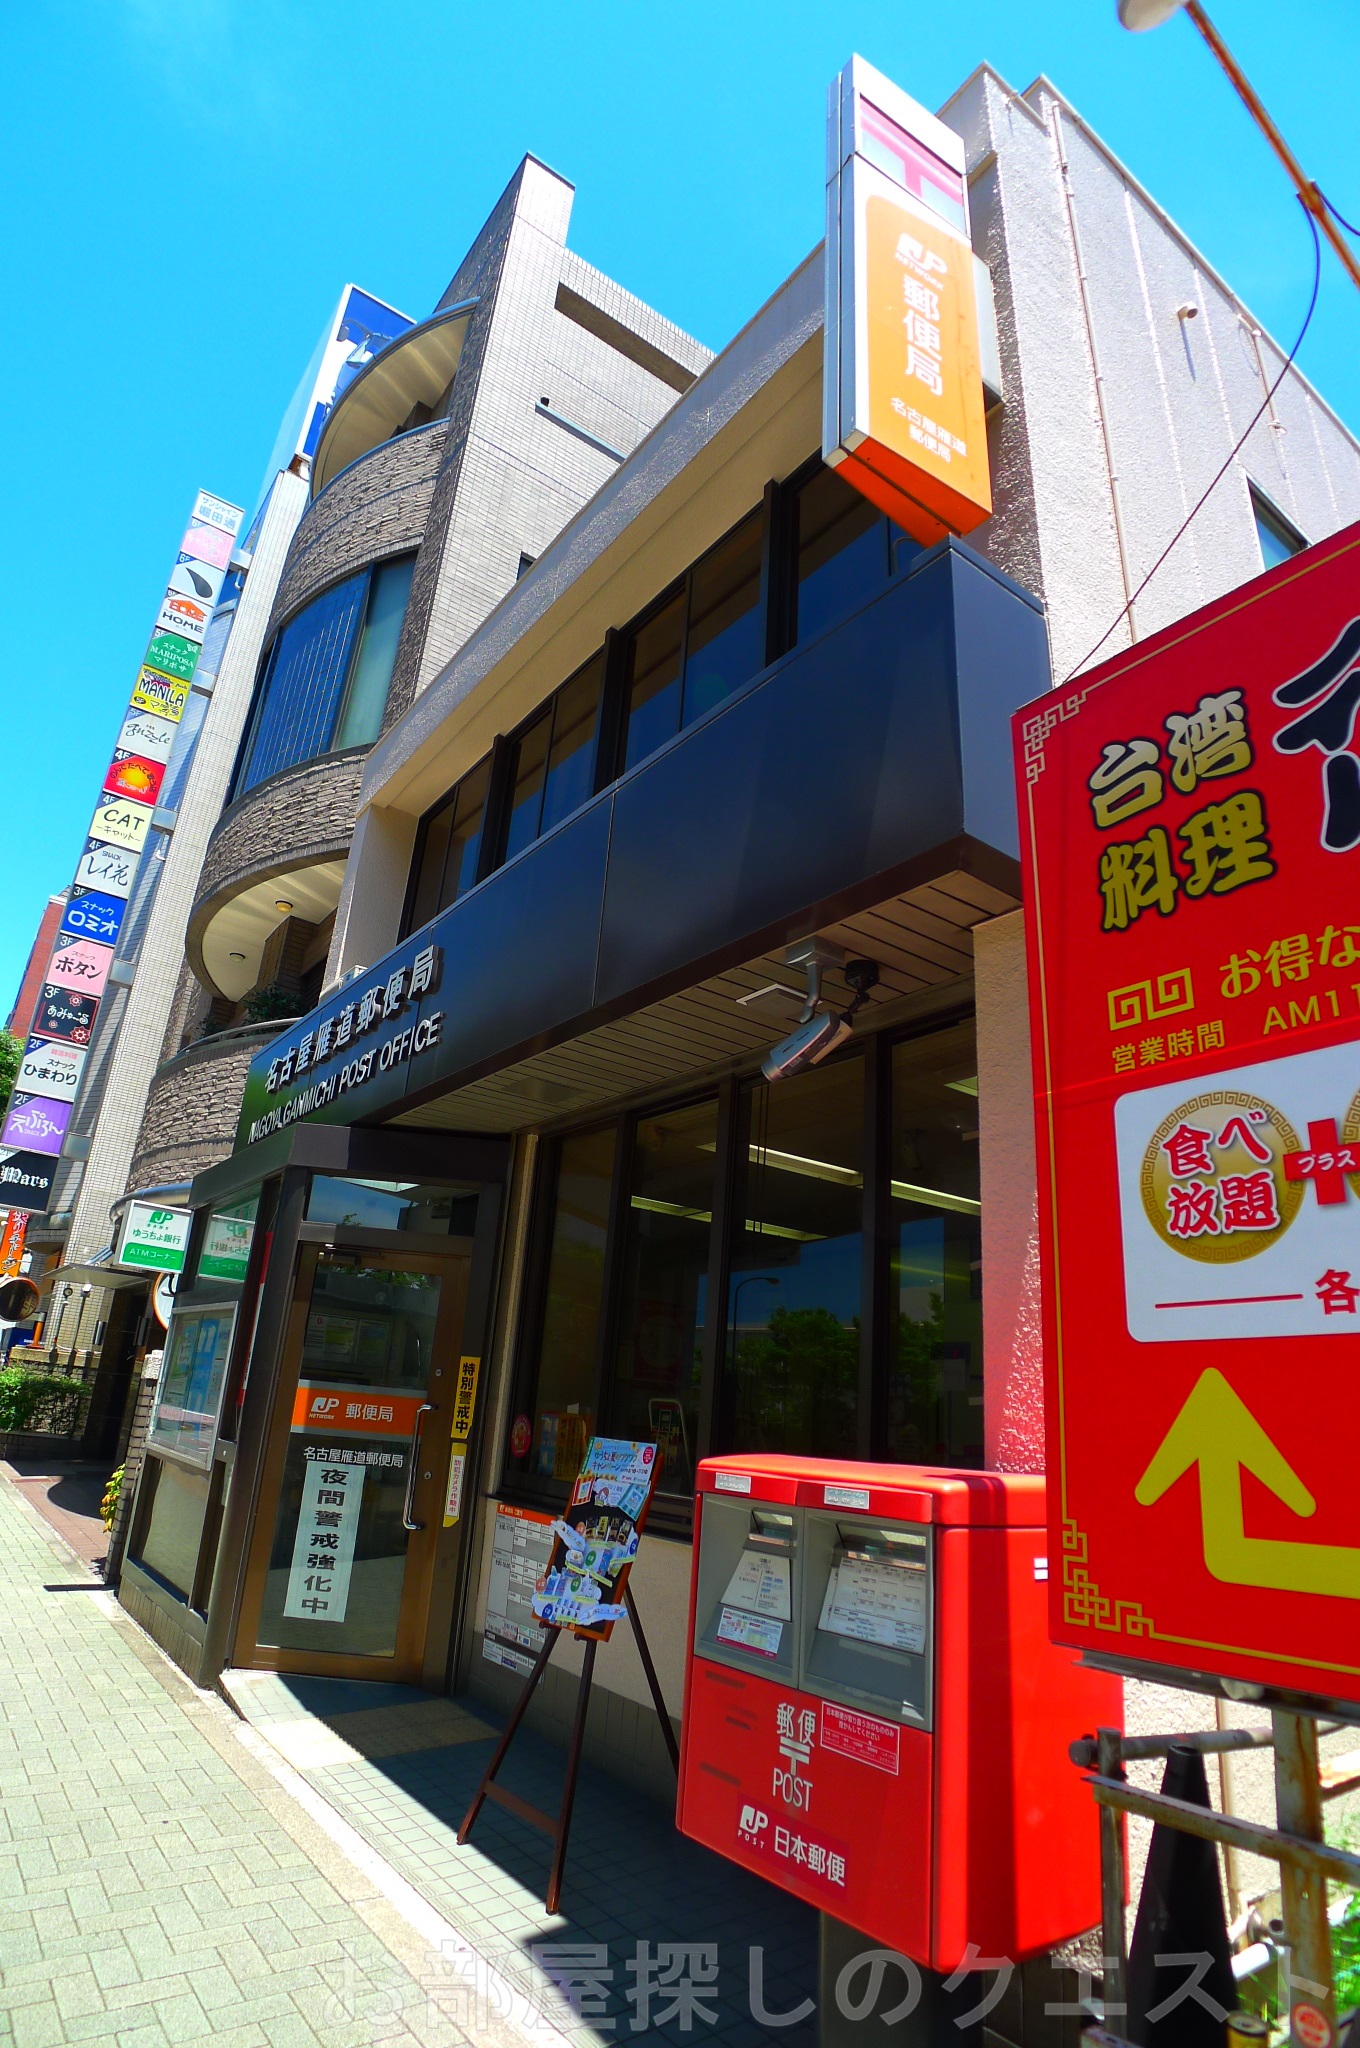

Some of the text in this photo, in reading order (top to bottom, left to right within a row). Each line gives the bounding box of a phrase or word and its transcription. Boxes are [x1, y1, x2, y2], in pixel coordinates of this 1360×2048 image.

[897, 232, 947, 274] JP
[895, 251, 943, 291] NETWORK
[903, 274, 943, 396] 郵便局
[909, 424, 951, 463] 郵便局
[180, 553, 191, 562] 6F
[161, 611, 204, 633] HOME
[149, 645, 194, 668] MARIPOSA
[138, 679, 184, 706] MANILA
[115, 750, 130, 760] 4F
[1088, 688, 1253, 830] 台湾
[103, 794, 116, 804] 4F
[103, 809, 145, 831] CAT
[89, 841, 102, 851] 4F
[1099, 789, 1276, 932] 料理
[73, 886, 86, 896] 3F
[81, 900, 115, 916] スナック
[67, 909, 119, 936] ロミオ
[60, 936, 74, 947] 3F
[55, 956, 104, 980] ボタン
[1219, 924, 1360, 999] お得な
[44, 985, 61, 998] 3F
[265, 945, 438, 1095] 名古屋雁道郵便局
[28, 1038, 43, 1049] 2F
[1111, 1019, 1226, 1075] 営業時間
[23, 1063, 78, 1086] ひまわり
[46, 1058, 76, 1071] スナック
[247, 1011, 445, 1145] NAGOYA GANMICHI POST OFFICE
[14, 1093, 30, 1106] 2F
[1298, 1149, 1357, 1174] プラス
[0, 1165, 49, 1189] Mars
[149, 1210, 174, 1225] JP
[132, 1228, 182, 1245] ゆうちょ銀行
[129, 1248, 177, 1261] ATMコーナー
[310, 1396, 340, 1414] JP
[454, 1361, 476, 1434] 特別警戒中
[308, 1412, 336, 1421] NETWORK
[345, 1402, 394, 1423] 郵便局
[303, 1446, 404, 1468] 名古屋雁道郵便局
[300, 1468, 348, 1615] 夜間警戒強化中
[776, 1702, 817, 1748] 郵便
[772, 1767, 814, 1812] POST
[739, 1804, 769, 1835] JP
[737, 1830, 765, 1849] POST
[774, 1826, 846, 1888] 日本郵便
